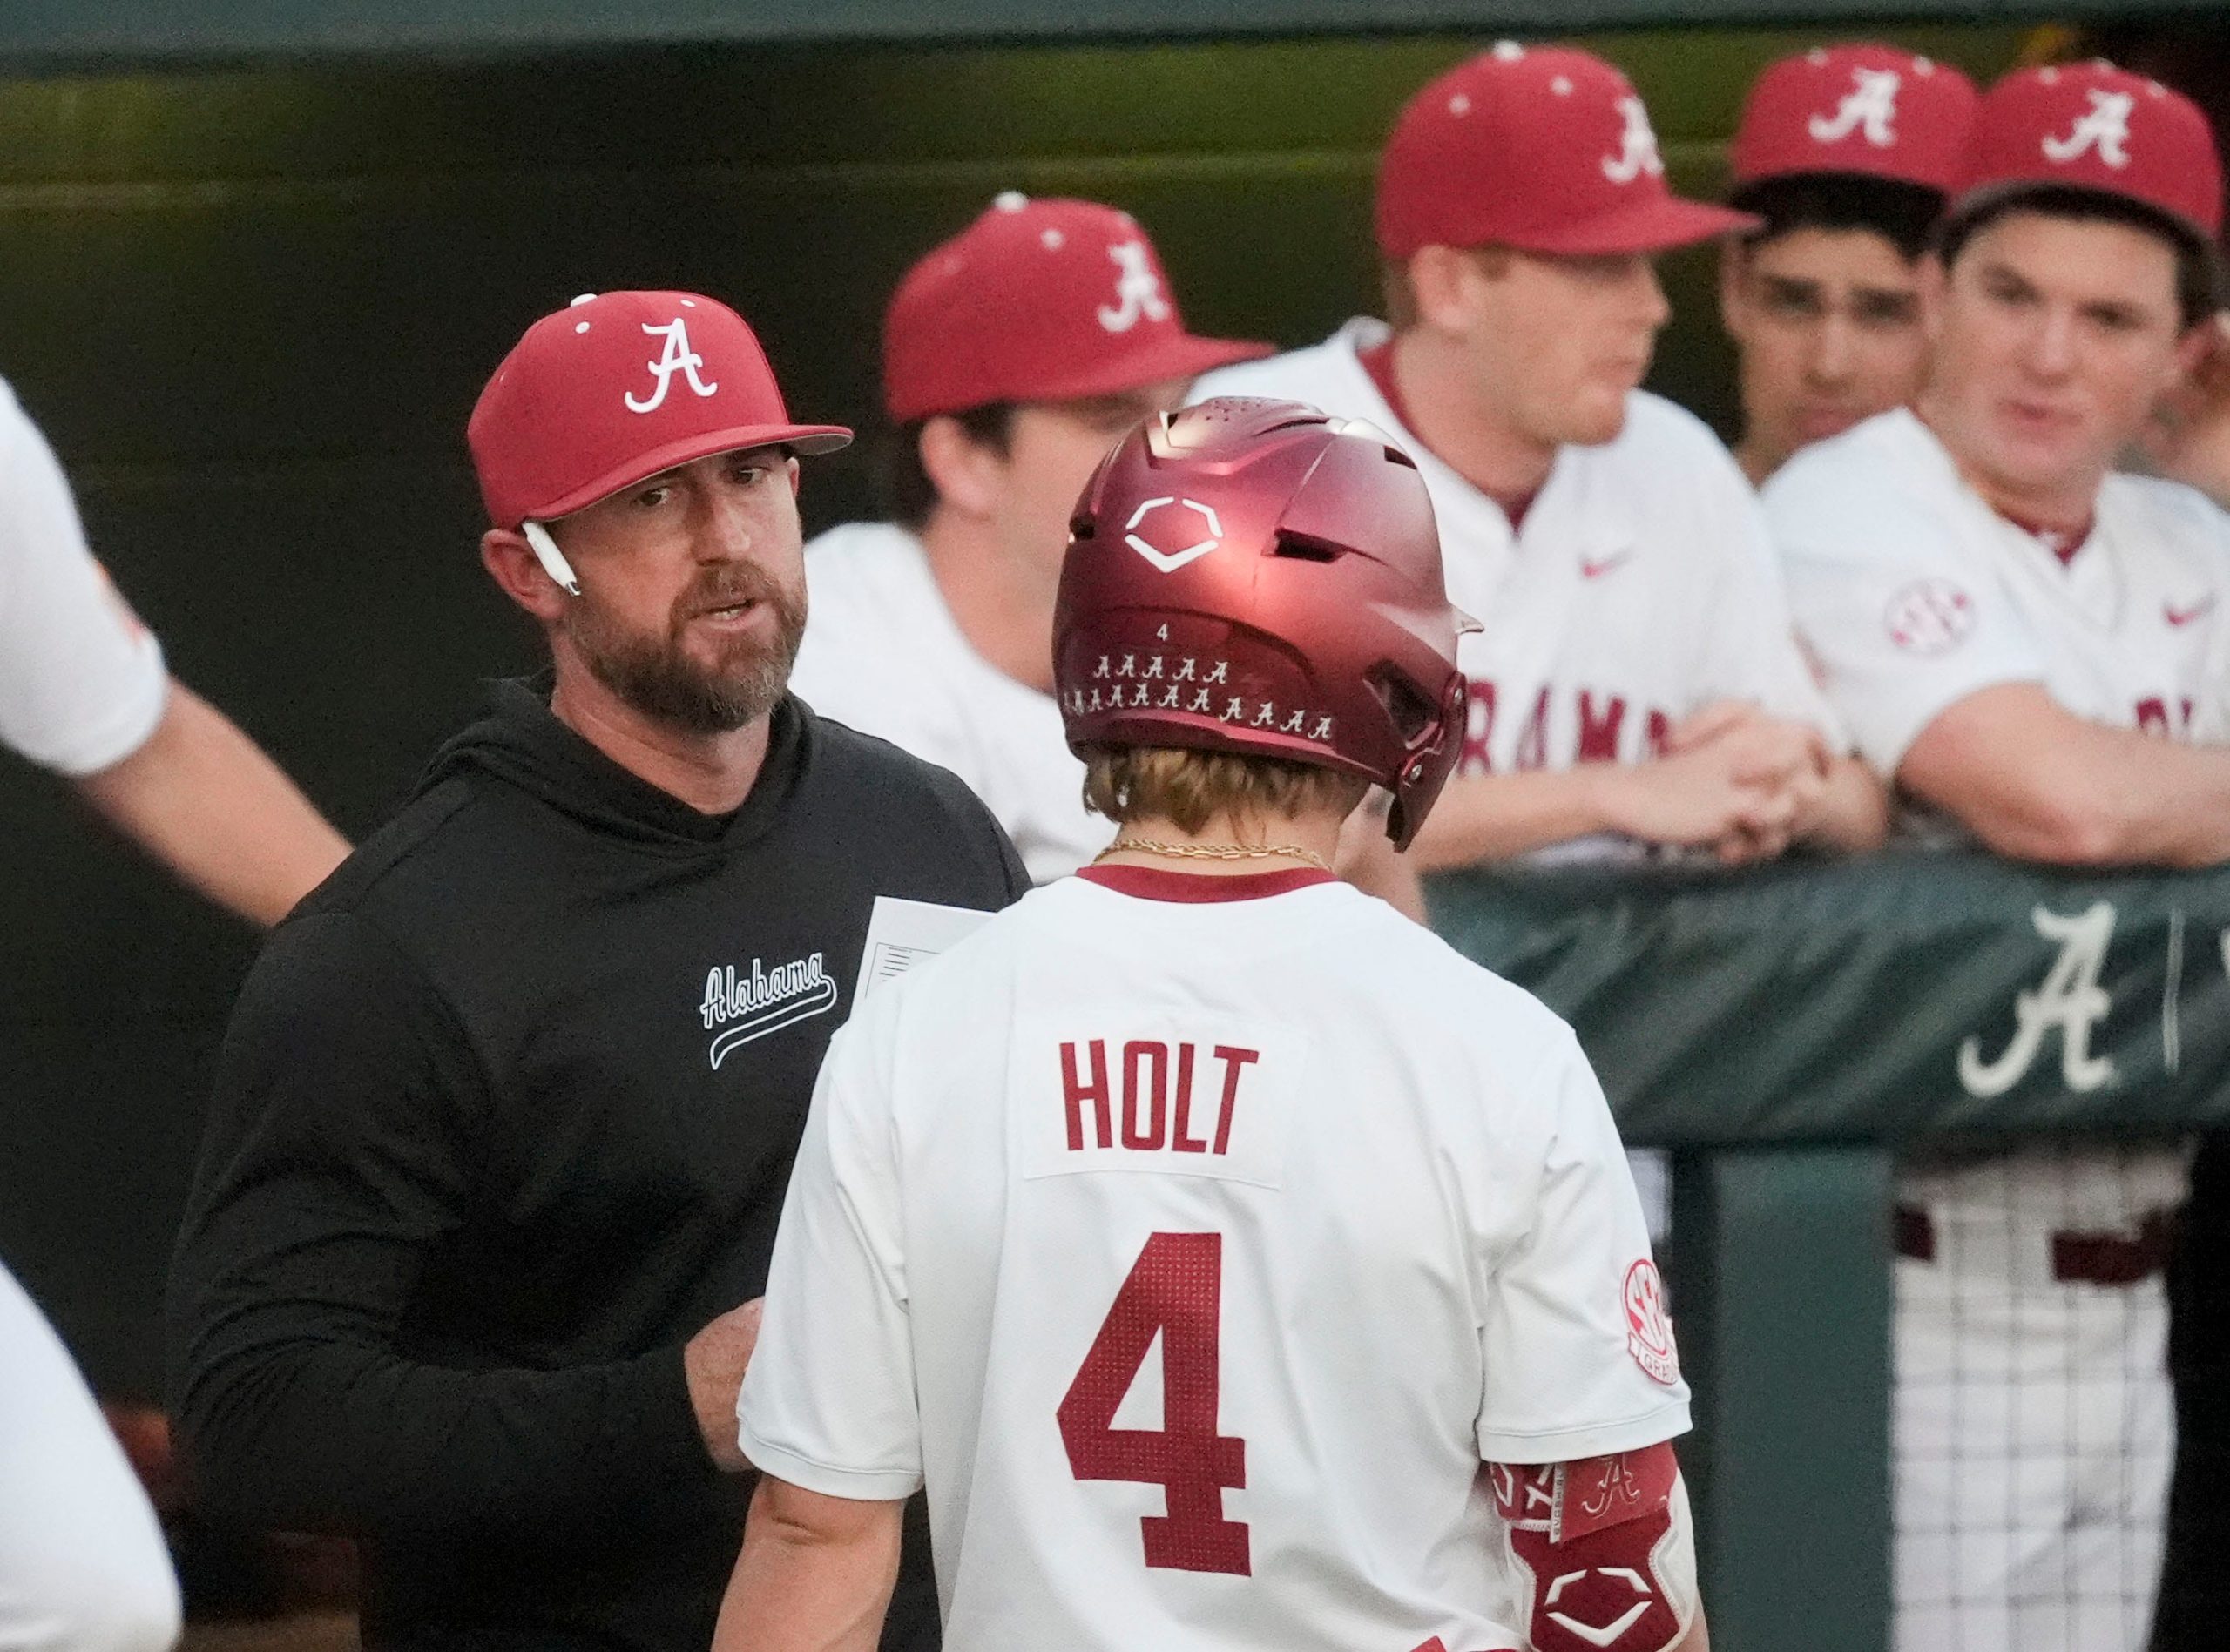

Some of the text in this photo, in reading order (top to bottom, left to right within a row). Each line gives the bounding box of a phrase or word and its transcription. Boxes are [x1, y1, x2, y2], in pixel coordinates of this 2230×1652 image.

[1602, 95, 1666, 185] A
[1808, 66, 1902, 148] A
[2040, 89, 2132, 169] A
[1098, 239, 1171, 334] A
[624, 317, 718, 414] A
[1093, 654, 1228, 684] A A A A A
[1156, 623, 1168, 642] 4
[1157, 684, 1179, 707] A
[1186, 688, 1210, 711] A
[1220, 698, 1242, 721] A
[1250, 702, 1274, 725] A
[1280, 710, 1305, 732] A
[1308, 717, 1332, 738] A
[700, 953, 831, 1031] Alabama
[1960, 901, 2117, 1096] A
[1059, 1039, 1260, 1155] HOLT
[1057, 1231, 1252, 1577] 4
